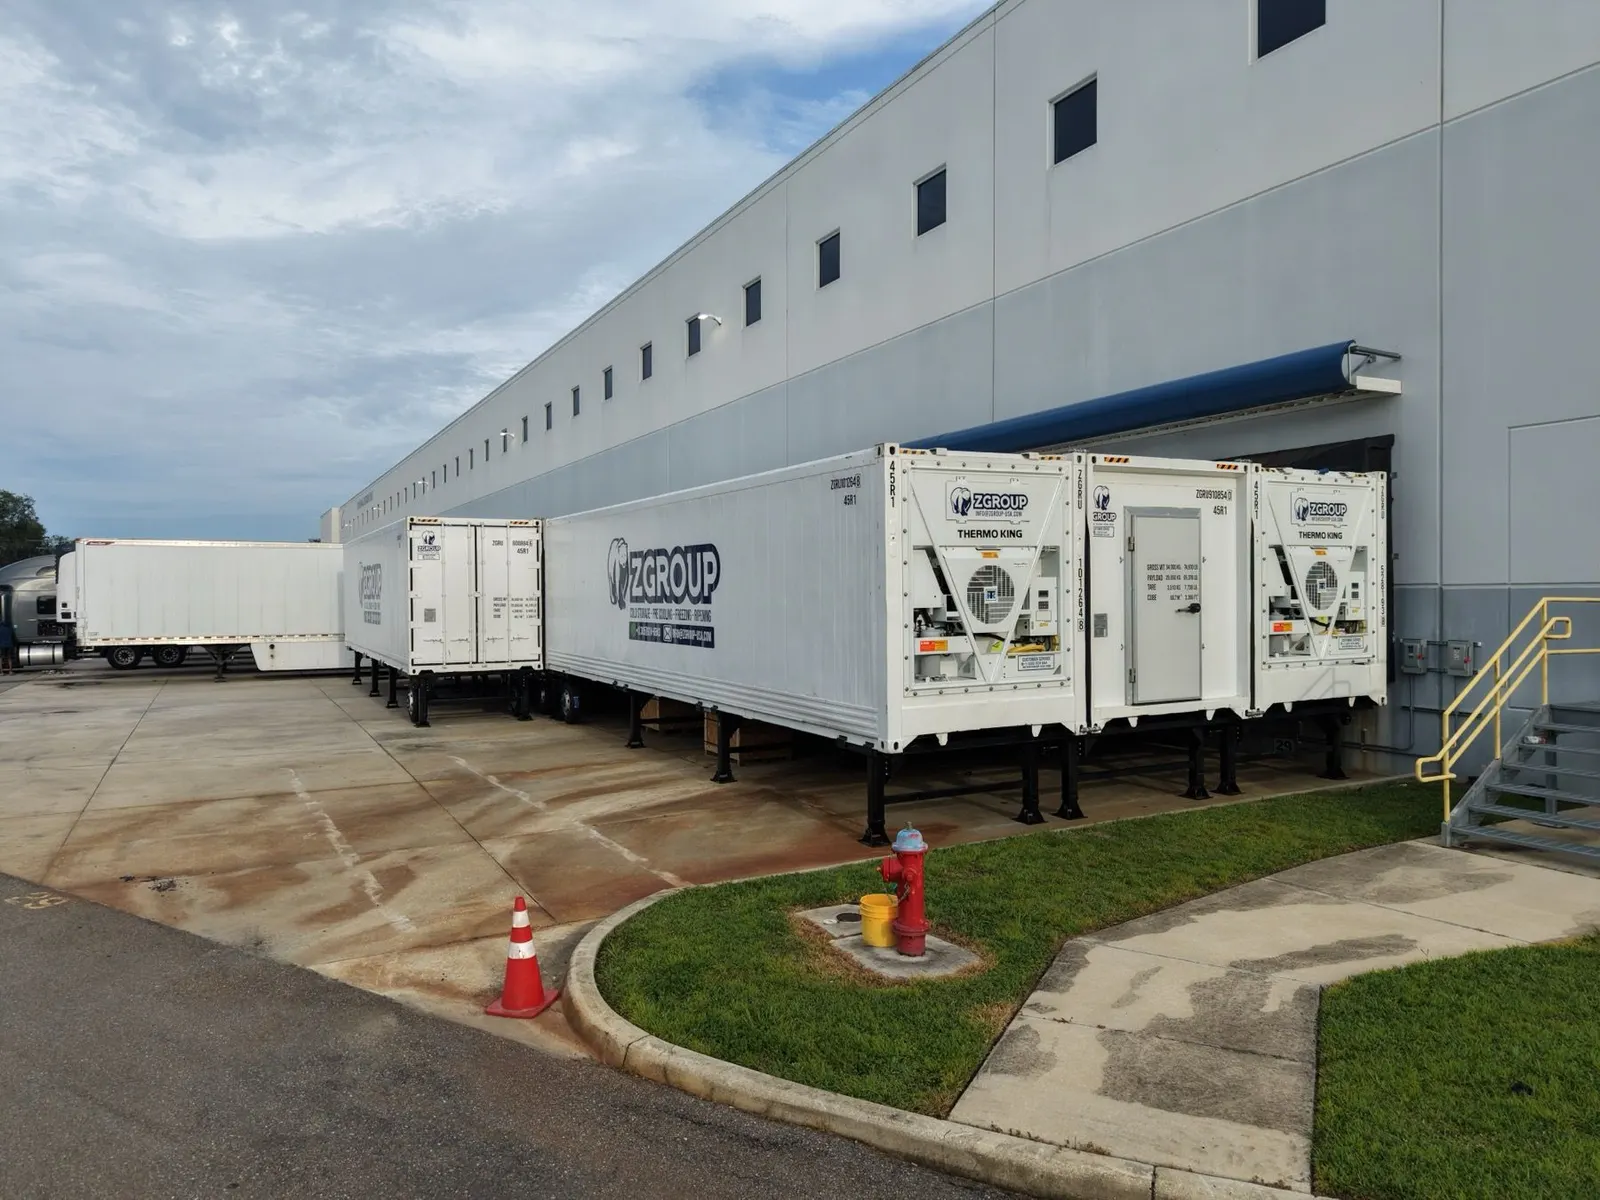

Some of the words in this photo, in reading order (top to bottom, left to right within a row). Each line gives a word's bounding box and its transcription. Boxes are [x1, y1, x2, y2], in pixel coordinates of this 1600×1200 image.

[972, 493, 1029, 510] ZGROUP
[1310, 502, 1347, 516] ZGROUP
[1092, 511, 1117, 522] GROUP
[957, 529, 999, 538] THERMO
[1000, 530, 1023, 538] KING
[1298, 531, 1326, 539] THERMO
[629, 543, 720, 605] ZGROUP
